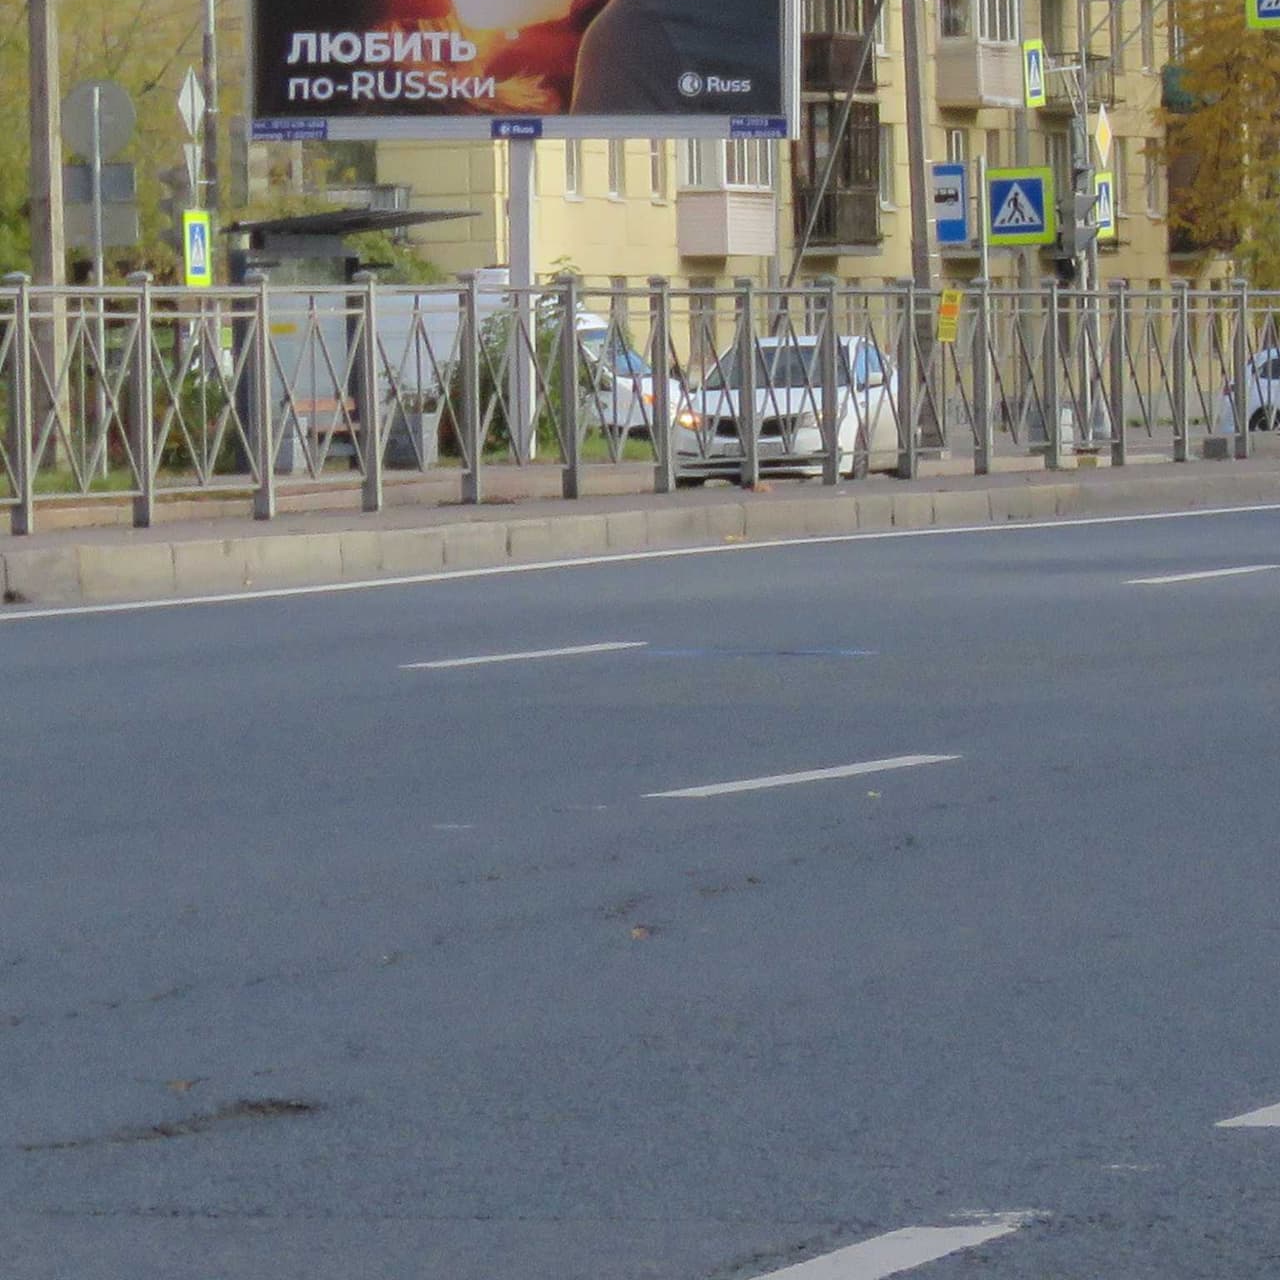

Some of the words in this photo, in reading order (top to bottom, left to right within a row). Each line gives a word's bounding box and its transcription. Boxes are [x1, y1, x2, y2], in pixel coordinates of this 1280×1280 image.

[287, 30, 478, 65] ЛЮБИТЬ
[288, 70, 497, 101] по-RUSSки
[706, 76, 751, 93] Russ
